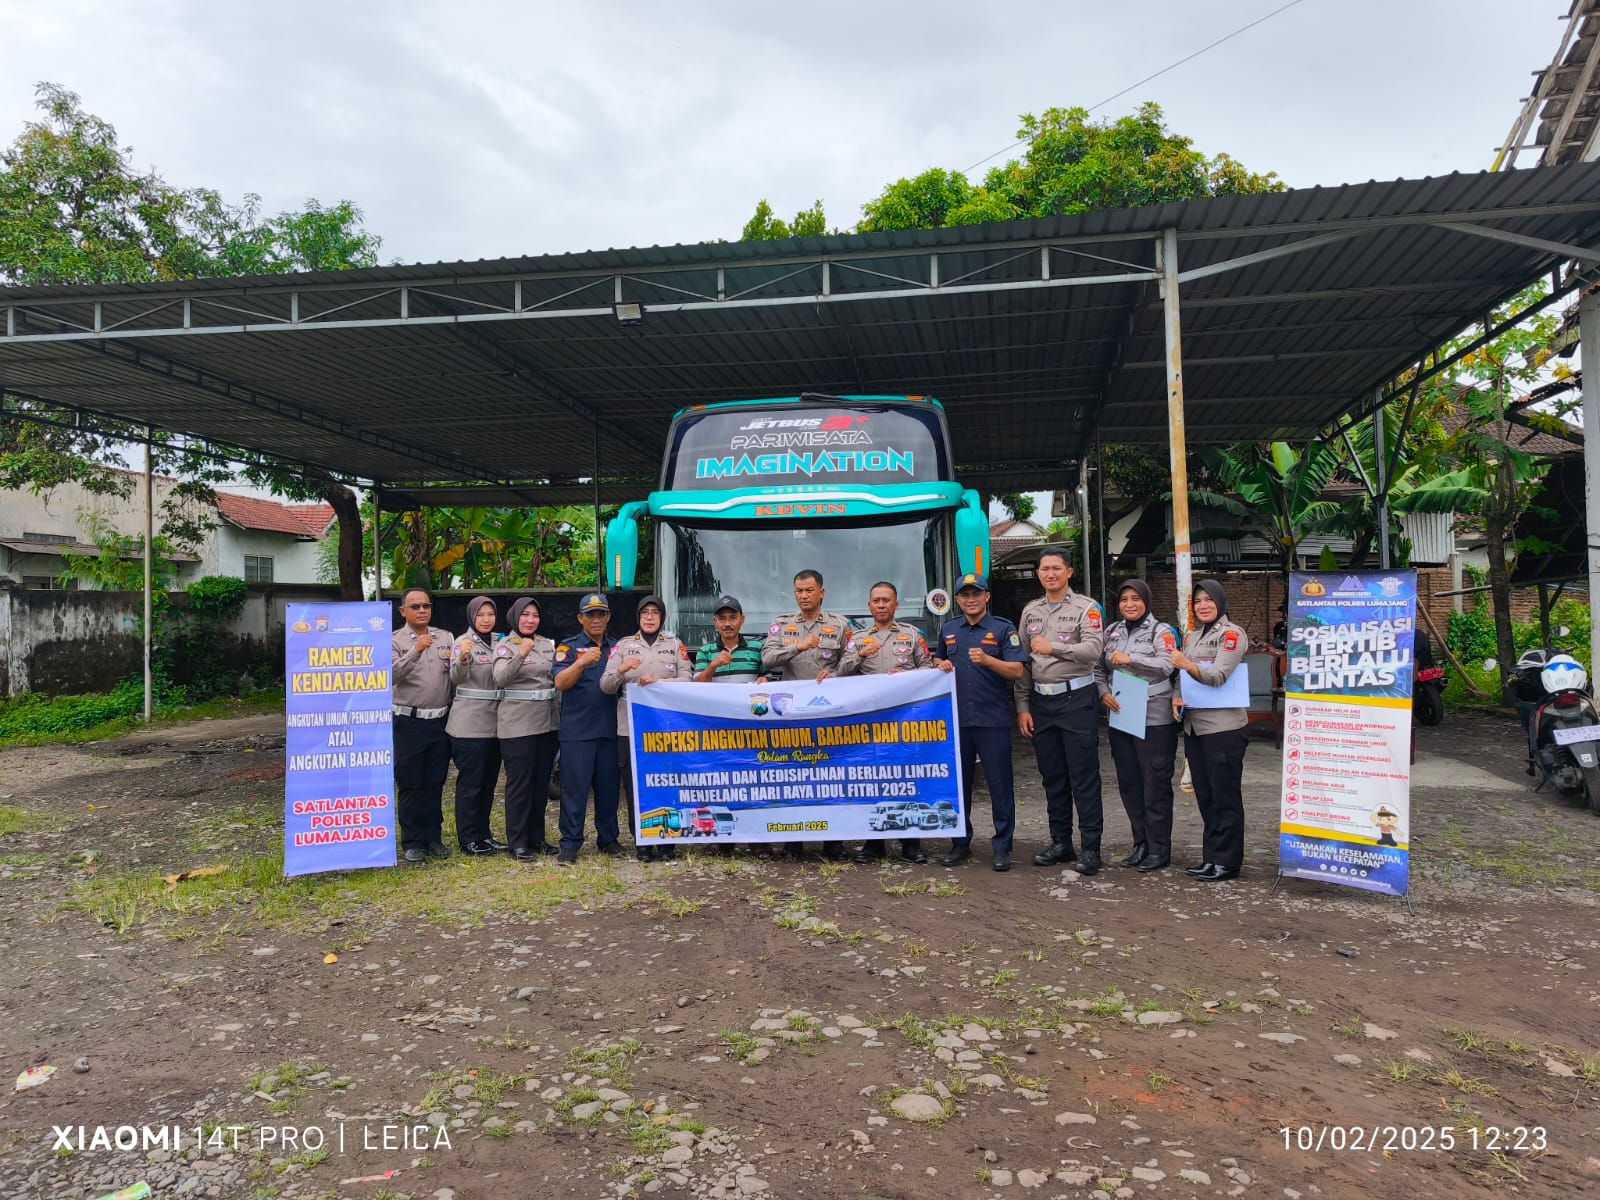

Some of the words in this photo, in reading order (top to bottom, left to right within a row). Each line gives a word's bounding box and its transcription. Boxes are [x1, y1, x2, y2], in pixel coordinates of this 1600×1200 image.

[740, 418, 823, 430] JETBUS
[731, 430, 873, 450] PARIWISATA
[696, 446, 914, 480] IMAGINATION
[754, 503, 848, 516] KEVIN
[1291, 617, 1411, 641] SOSIALISASI
[1305, 633, 1396, 657] TERTIB
[308, 646, 374, 669] RAMCEK
[1291, 648, 1410, 674] BERLALU
[292, 670, 388, 694] KENDARAAN
[1304, 668, 1395, 690] LINTAS
[287, 712, 324, 727] ANGKUTAN
[328, 730, 354, 747] ATAU
[643, 730, 699, 752] INSPEKSI
[702, 729, 768, 752] ANGKUTAN
[770, 725, 815, 749] UMUM,
[817, 723, 870, 747] BARANG
[872, 721, 899, 743] DAN
[901, 719, 947, 742] ORANG
[289, 752, 346, 771] ANGKUTAN
[350, 750, 391, 768] BARANG
[757, 750, 789, 763] Dalam
[792, 749, 830, 765] Rangka
[646, 771, 729, 787] KESELAMATAN
[732, 770, 757, 785] DAN
[761, 766, 845, 784] KEDISIPLINAN
[848, 765, 902, 781] BERLALU
[905, 763, 949, 779] LINTAS
[679, 788, 747, 803] MENJELANG
[751, 786, 780, 801] HARI
[783, 785, 814, 800] RAYA
[816, 783, 845, 798] IDUL
[848, 782, 879, 798] FITRI
[881, 781, 916, 797] 2025
[293, 795, 388, 814] SATLANTAS
[311, 812, 370, 829] POLRES
[767, 822, 803, 832] Februari
[805, 820, 828, 831] 2025
[295, 827, 387, 846] LUMAJANG
[1302, 849, 1331, 861] BUKAN
